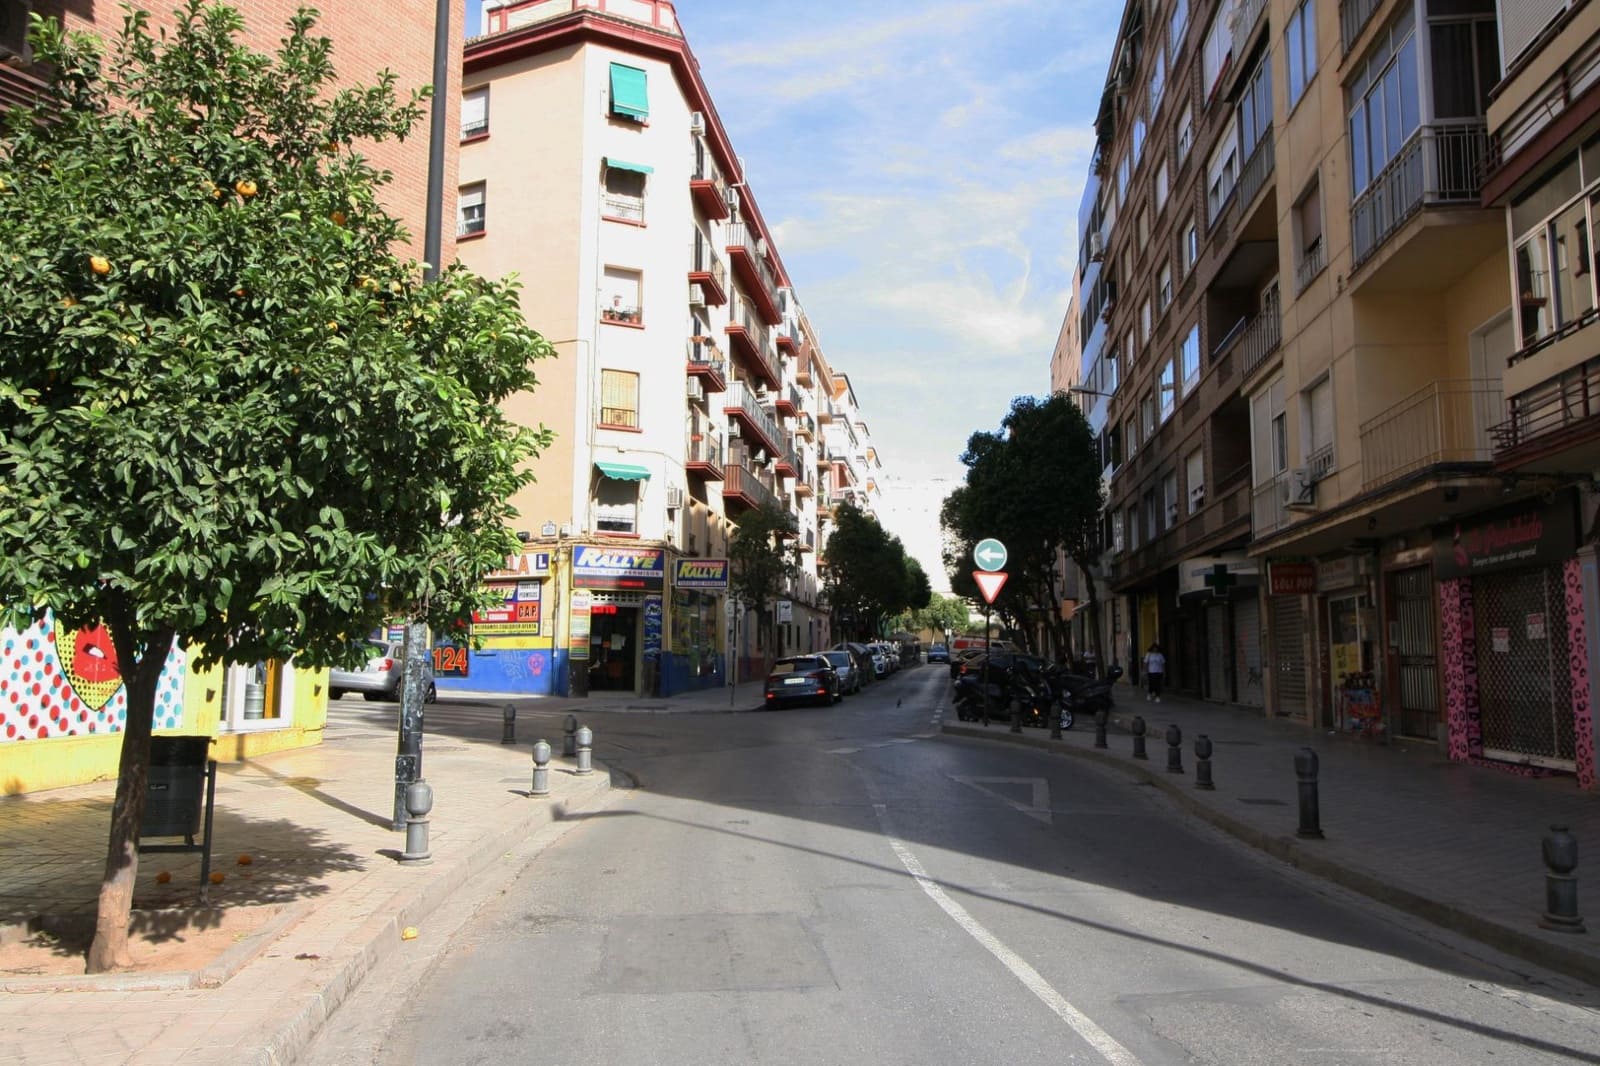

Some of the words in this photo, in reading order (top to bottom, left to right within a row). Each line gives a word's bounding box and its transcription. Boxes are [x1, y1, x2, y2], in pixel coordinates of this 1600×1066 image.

[577, 548, 656, 568] RALLYE
[679, 562, 723, 578] RALLYE
[432, 646, 467, 671] 124
